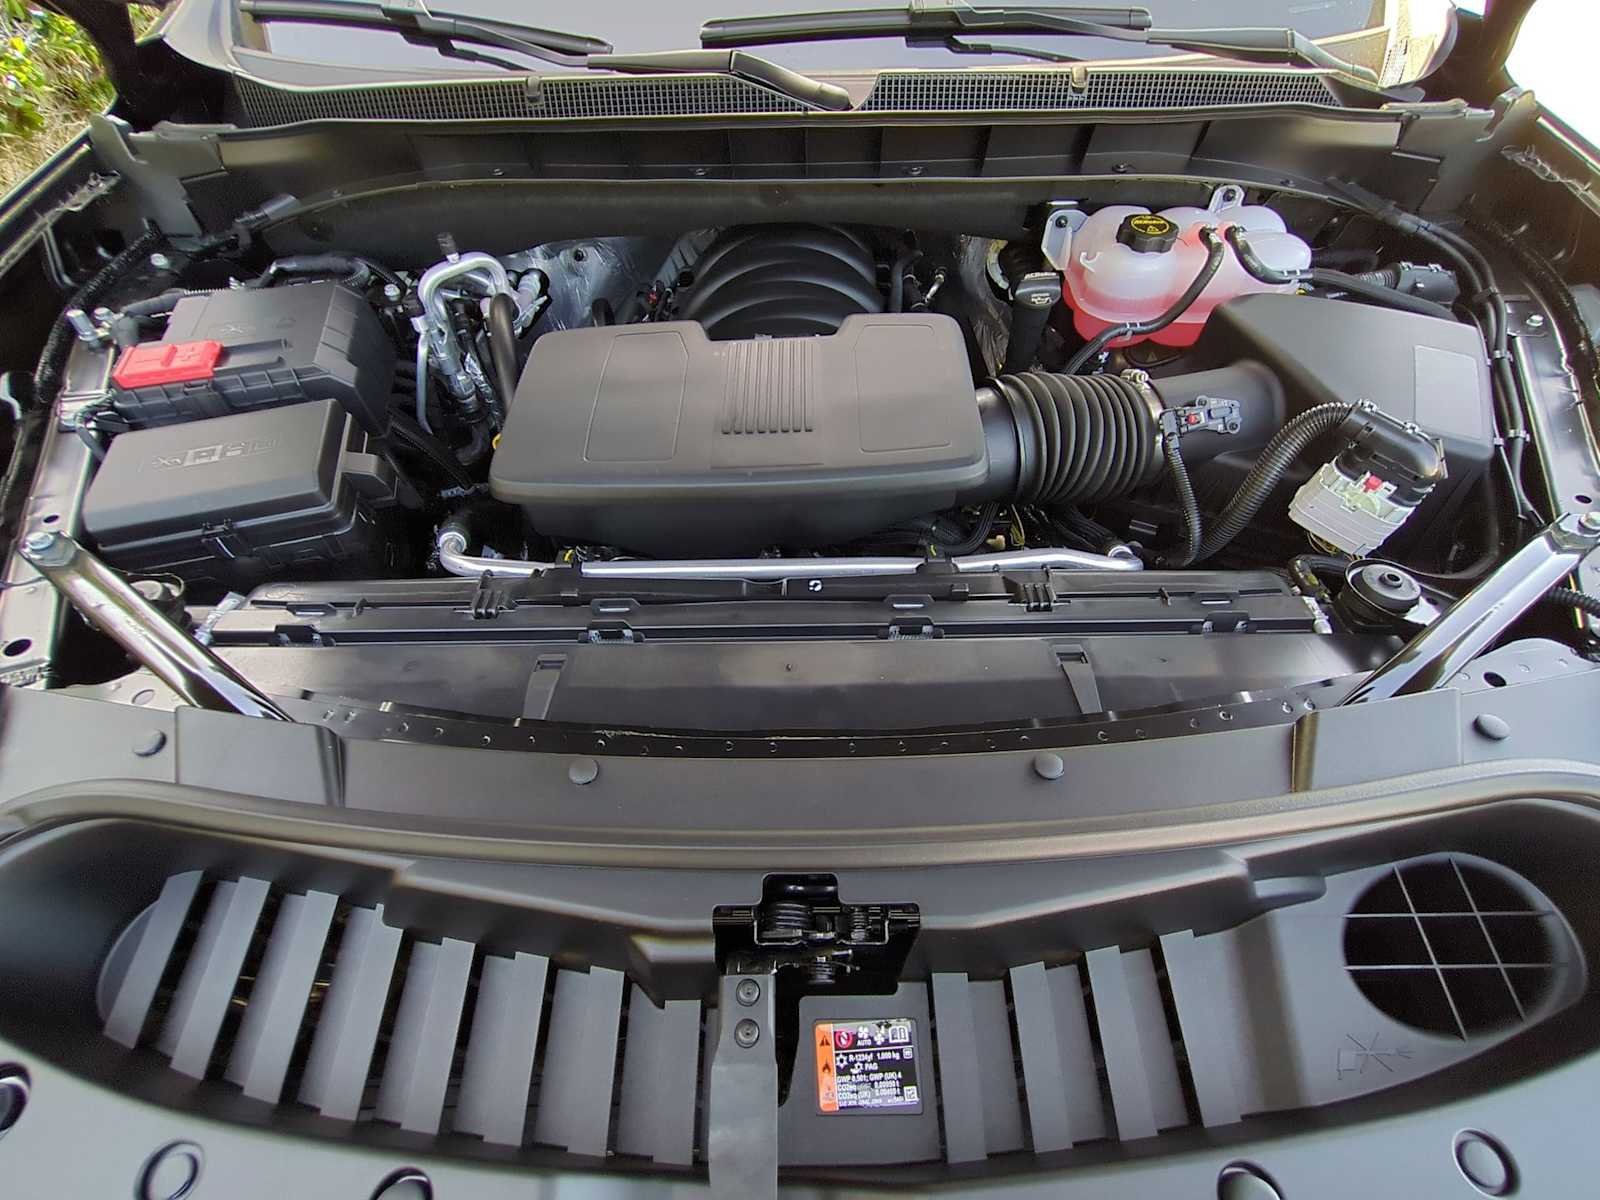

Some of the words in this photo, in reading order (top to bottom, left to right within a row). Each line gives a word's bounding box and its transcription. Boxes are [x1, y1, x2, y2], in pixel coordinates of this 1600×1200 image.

[849, 1053, 874, 1062] R-1234yf
[892, 1051, 900, 1060] kg
[865, 1062, 878, 1071] PAG
[869, 1073, 884, 1081] GWP
[884, 1072, 897, 1080] (UK)
